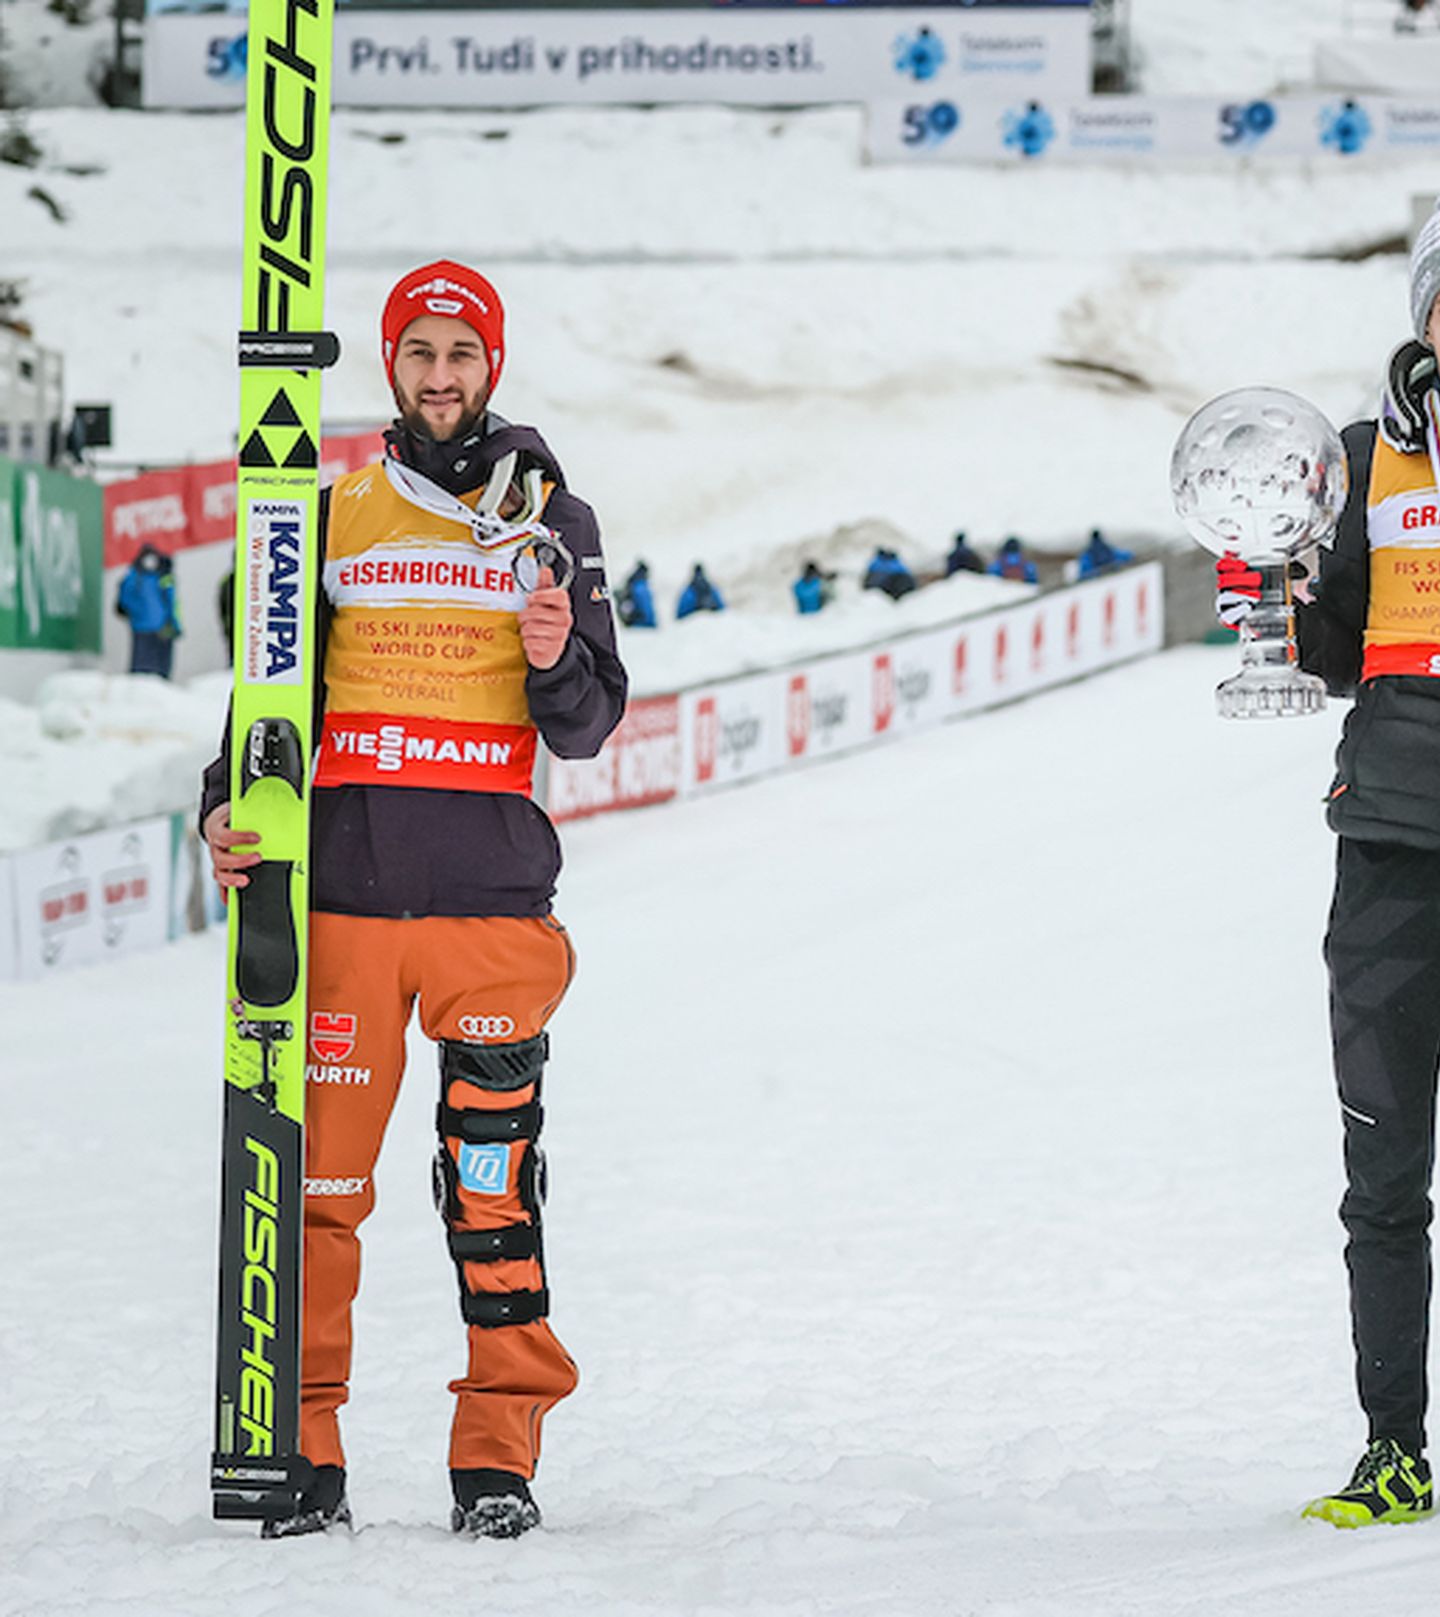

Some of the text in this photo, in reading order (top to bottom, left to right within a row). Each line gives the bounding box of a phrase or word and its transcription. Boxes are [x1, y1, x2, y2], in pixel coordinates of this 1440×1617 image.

[351, 36, 826, 81] Prvi. Tudi v prihodnosti.
[339, 561, 515, 593] EISENBICHLER
[1393, 560, 1420, 576] FIS
[266, 521, 300, 679] KAMPA
[354, 620, 495, 643] FIS SKI JUMPING
[370, 641, 477, 661] WORLD CUP
[331, 725, 513, 772] VIESSMANN
[303, 1065, 371, 1085] URTH
